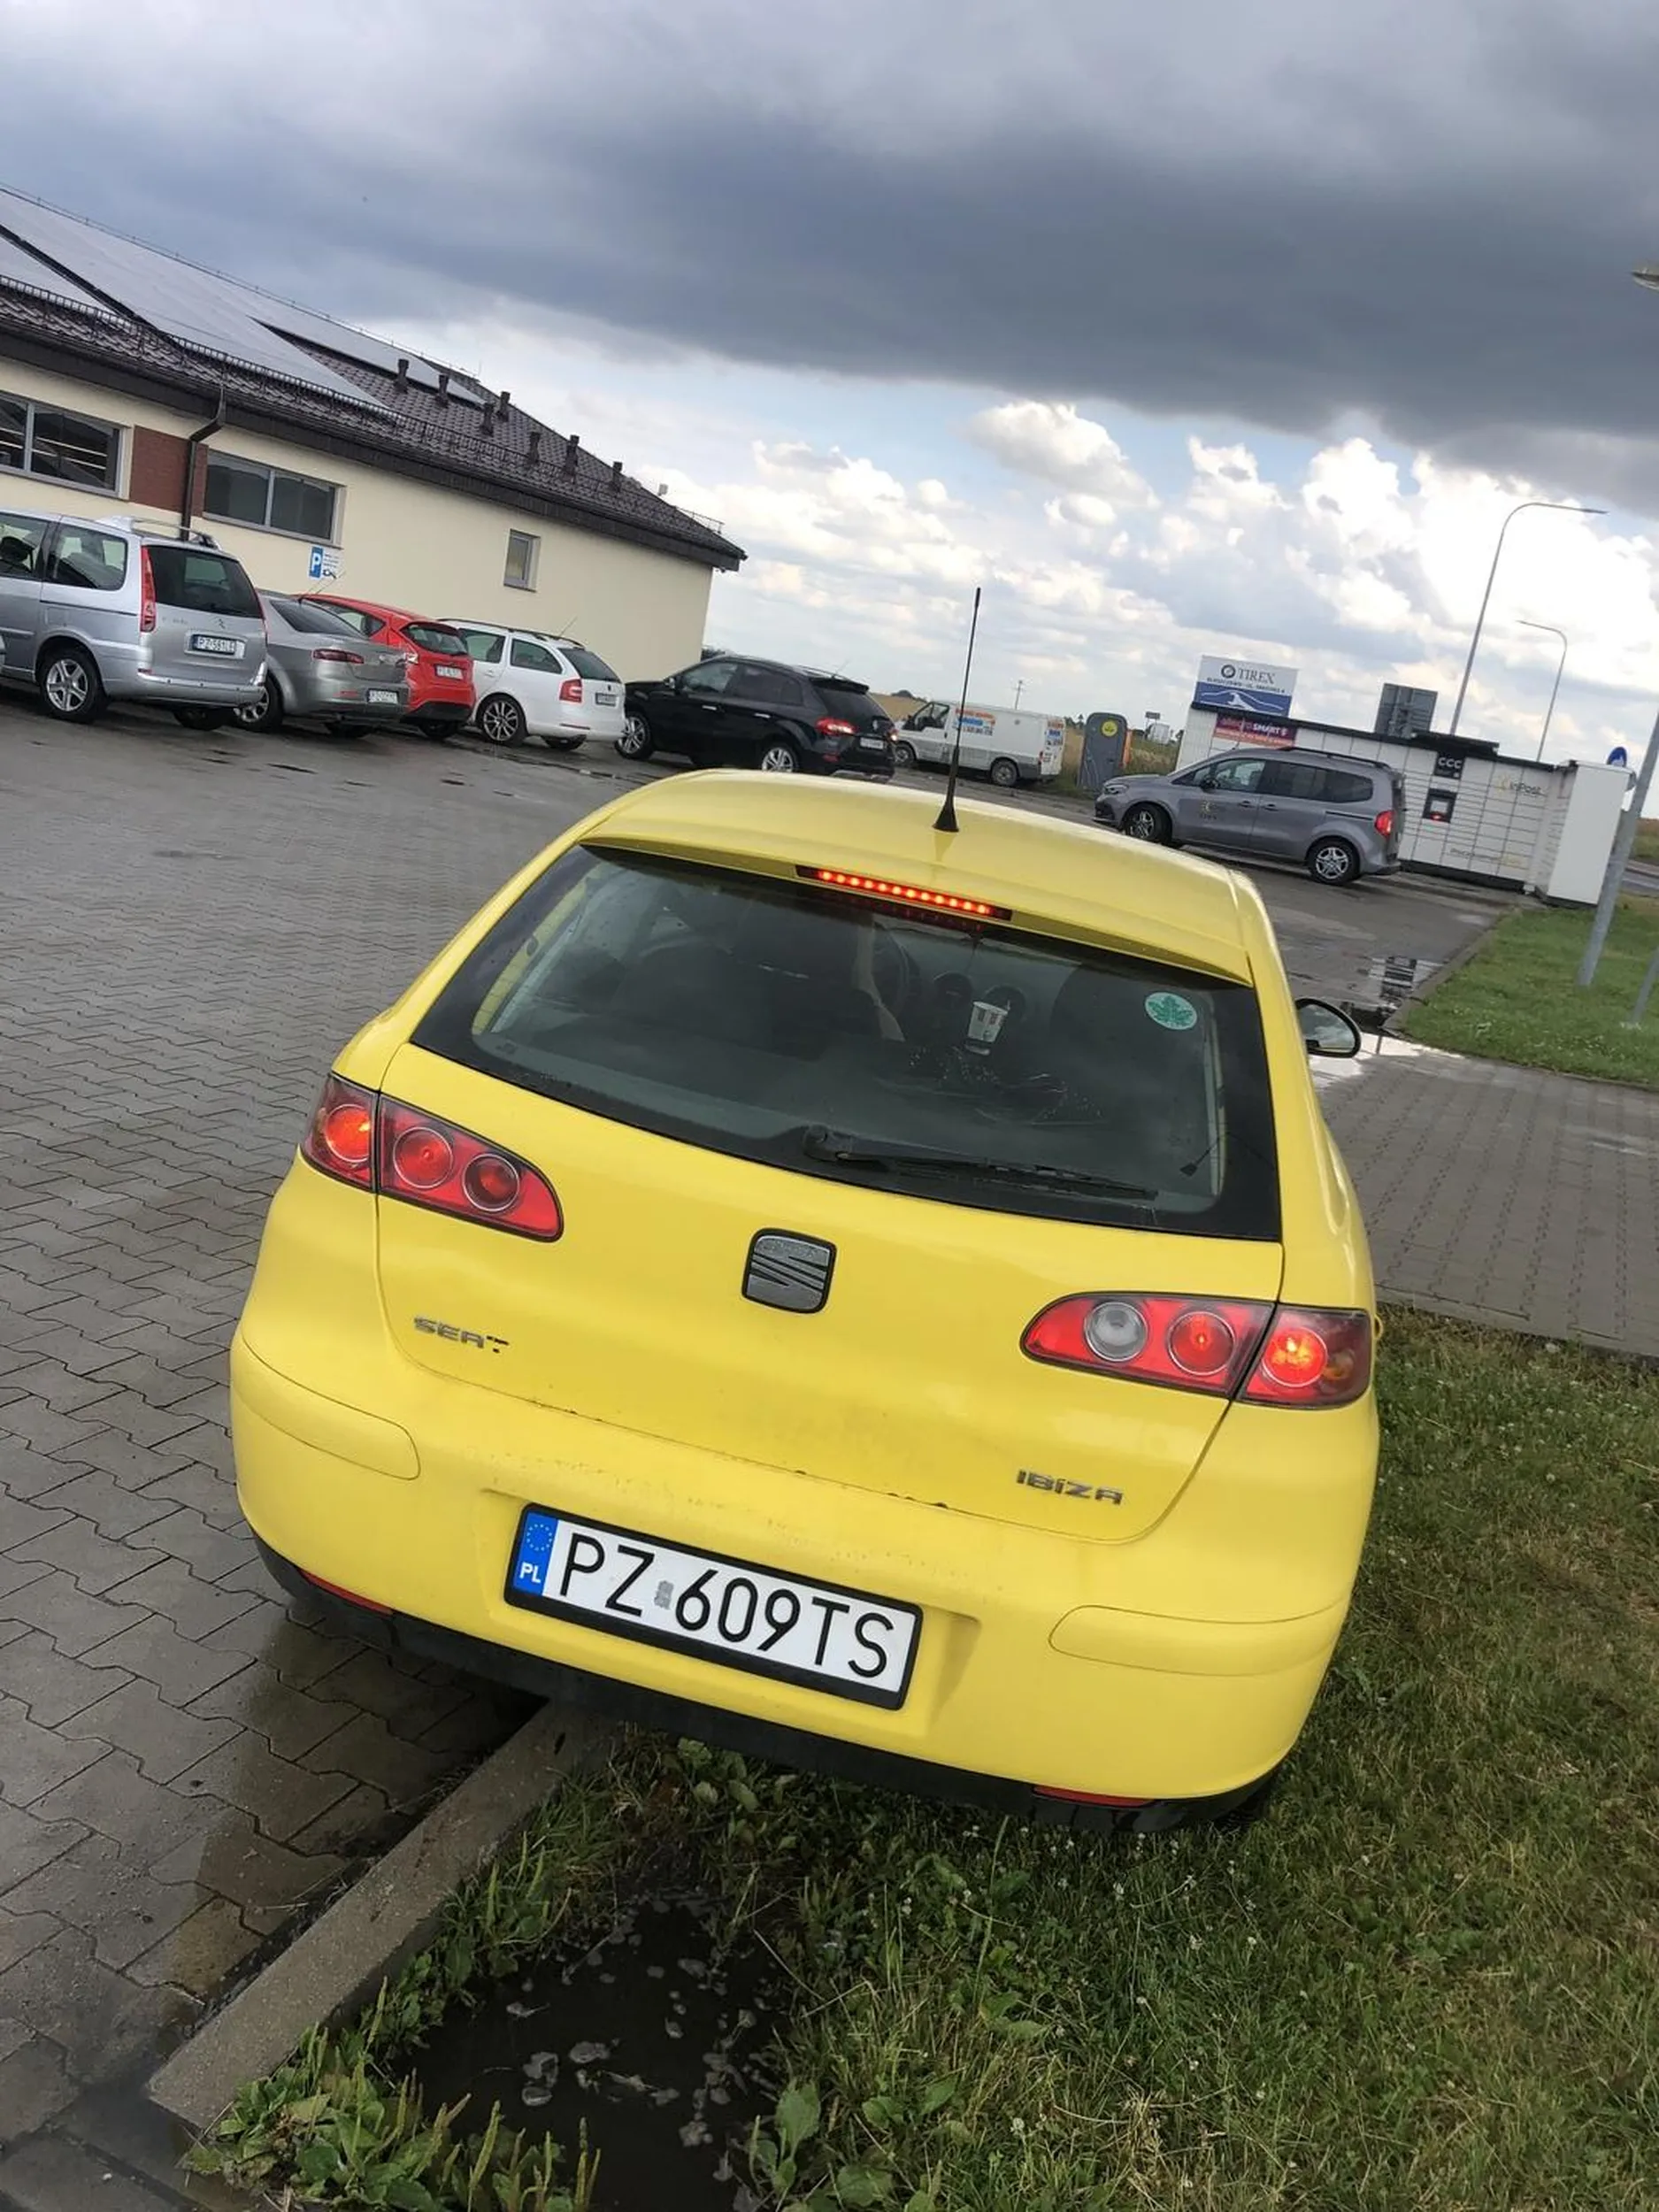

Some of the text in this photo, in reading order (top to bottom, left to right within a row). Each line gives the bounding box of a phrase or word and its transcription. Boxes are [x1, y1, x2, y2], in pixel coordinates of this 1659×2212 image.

[1238, 667, 1276, 685] TIREX
[1438, 757, 1463, 769] CCC
[413, 1317, 510, 1354] SEAT
[518, 1561, 541, 1584] PL
[560, 1532, 895, 1678] PZ 609TS
